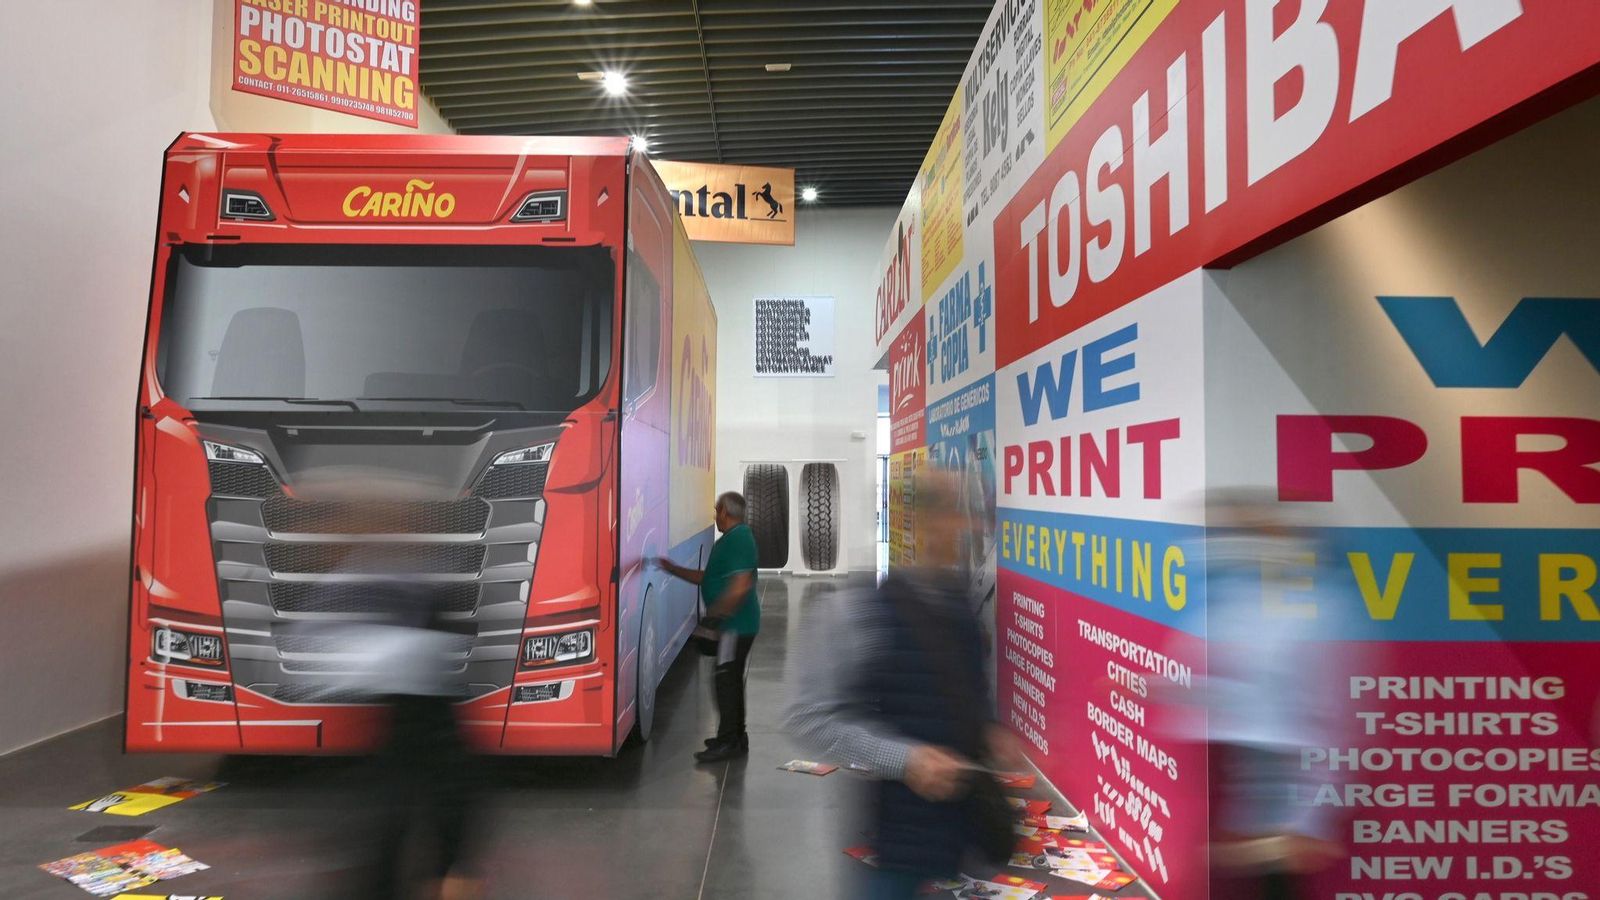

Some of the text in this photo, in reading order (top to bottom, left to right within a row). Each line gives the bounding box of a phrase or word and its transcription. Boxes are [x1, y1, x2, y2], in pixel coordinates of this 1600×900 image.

[315, 1, 415, 45] PRINTOUT
[332, 0, 415, 23] DING
[240, 5, 415, 75] PHOTOSTAT
[239, 39, 414, 110] SCANNING
[983, 67, 1009, 161] Kely
[342, 179, 456, 218] CARIÑO
[939, 270, 971, 342] FARMA
[941, 323, 969, 384] COPIA
[1016, 322, 1140, 427] WE
[1003, 417, 1180, 500] PRINT
[1002, 520, 1187, 611] EVERYTHING
[1013, 592, 1045, 618] PRINTING
[1014, 612, 1044, 640] T-SHIRTS
[1007, 628, 1054, 668] PHOTOCOPIES
[1077, 619, 1191, 689] TRANSPORTATION
[1005, 646, 1056, 693] LARGE FORMAT
[1013, 671, 1045, 708] BANNERS
[1107, 660, 1147, 698] CITIES
[1350, 676, 1566, 700] PRINTING
[1012, 691, 1028, 717] NEW
[1110, 690, 1145, 727] CASH
[1356, 711, 1559, 736] T-SHIRTS
[1011, 709, 1049, 756] PVC CARDS
[1087, 701, 1134, 751] BORDER
[1136, 735, 1178, 781] MAPS
[1352, 819, 1569, 844] BANNERS
[1350, 856, 1454, 880] NEW
